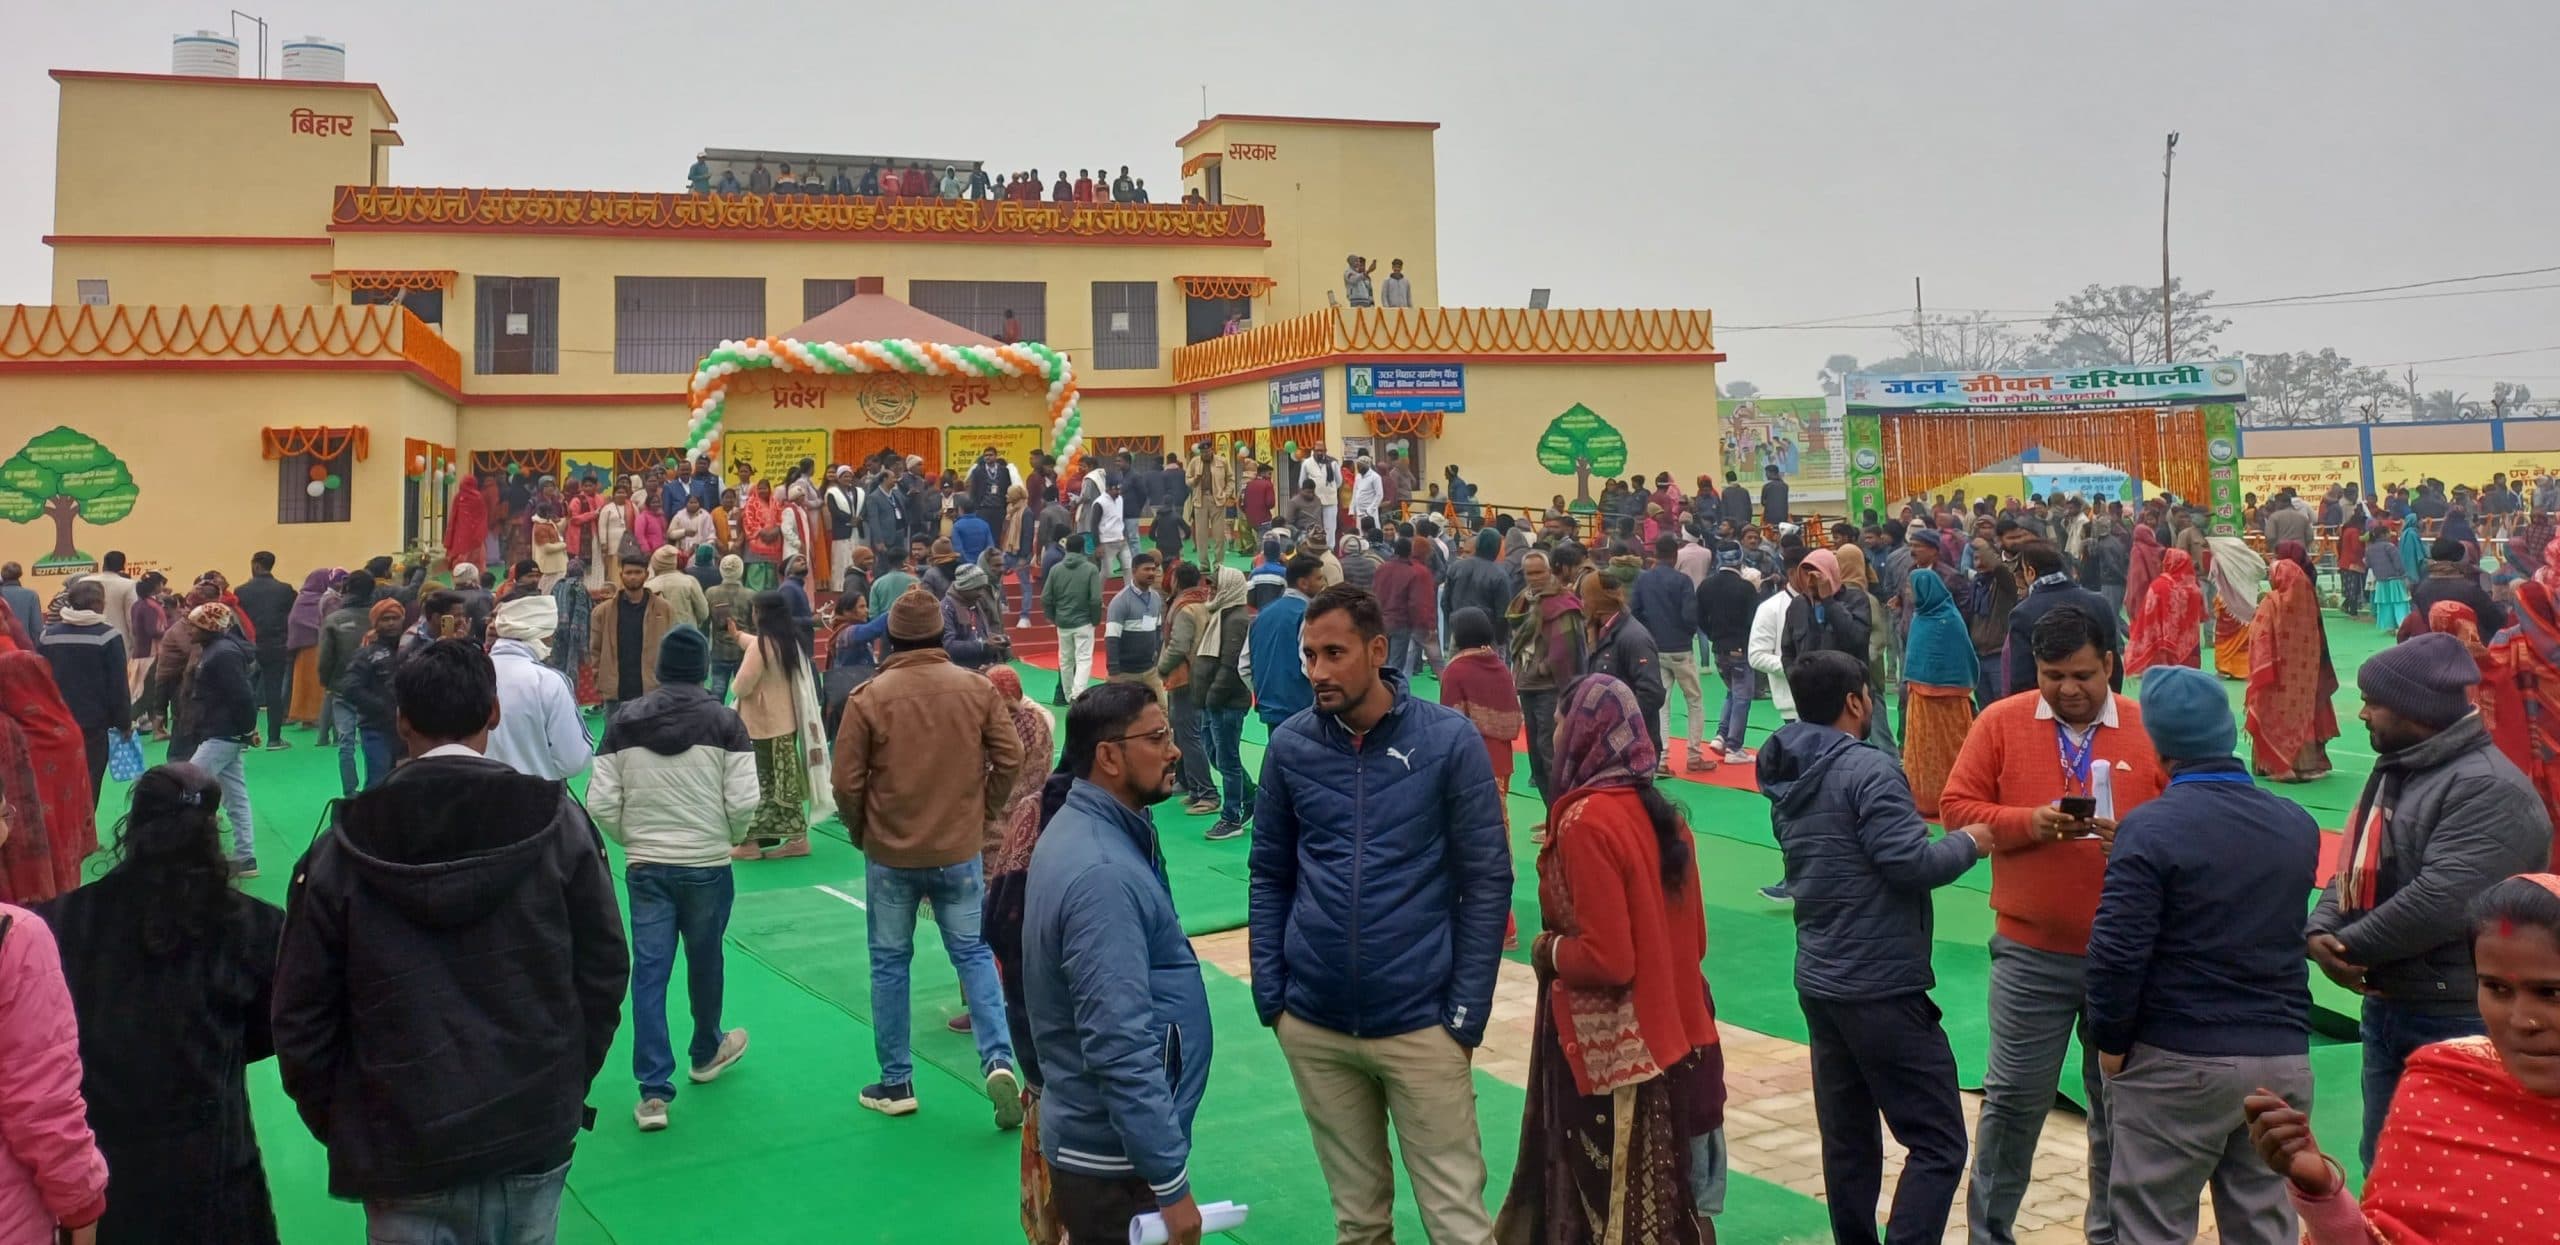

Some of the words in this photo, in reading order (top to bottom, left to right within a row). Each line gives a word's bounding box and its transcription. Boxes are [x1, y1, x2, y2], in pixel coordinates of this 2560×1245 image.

[290, 108, 353, 137] बिहार
[1229, 143, 1277, 161] सरकार
[479, 196, 579, 221] सरकार
[589, 198, 657, 222] भवन
[772, 381, 826, 410] प्रवेश
[950, 384, 991, 414] द्वार
[1968, 394, 1998, 404] तभी
[2004, 393, 2039, 404] होगी
[2046, 390, 2116, 403] खुशहाली
[126, 567, 141, 577] 112
